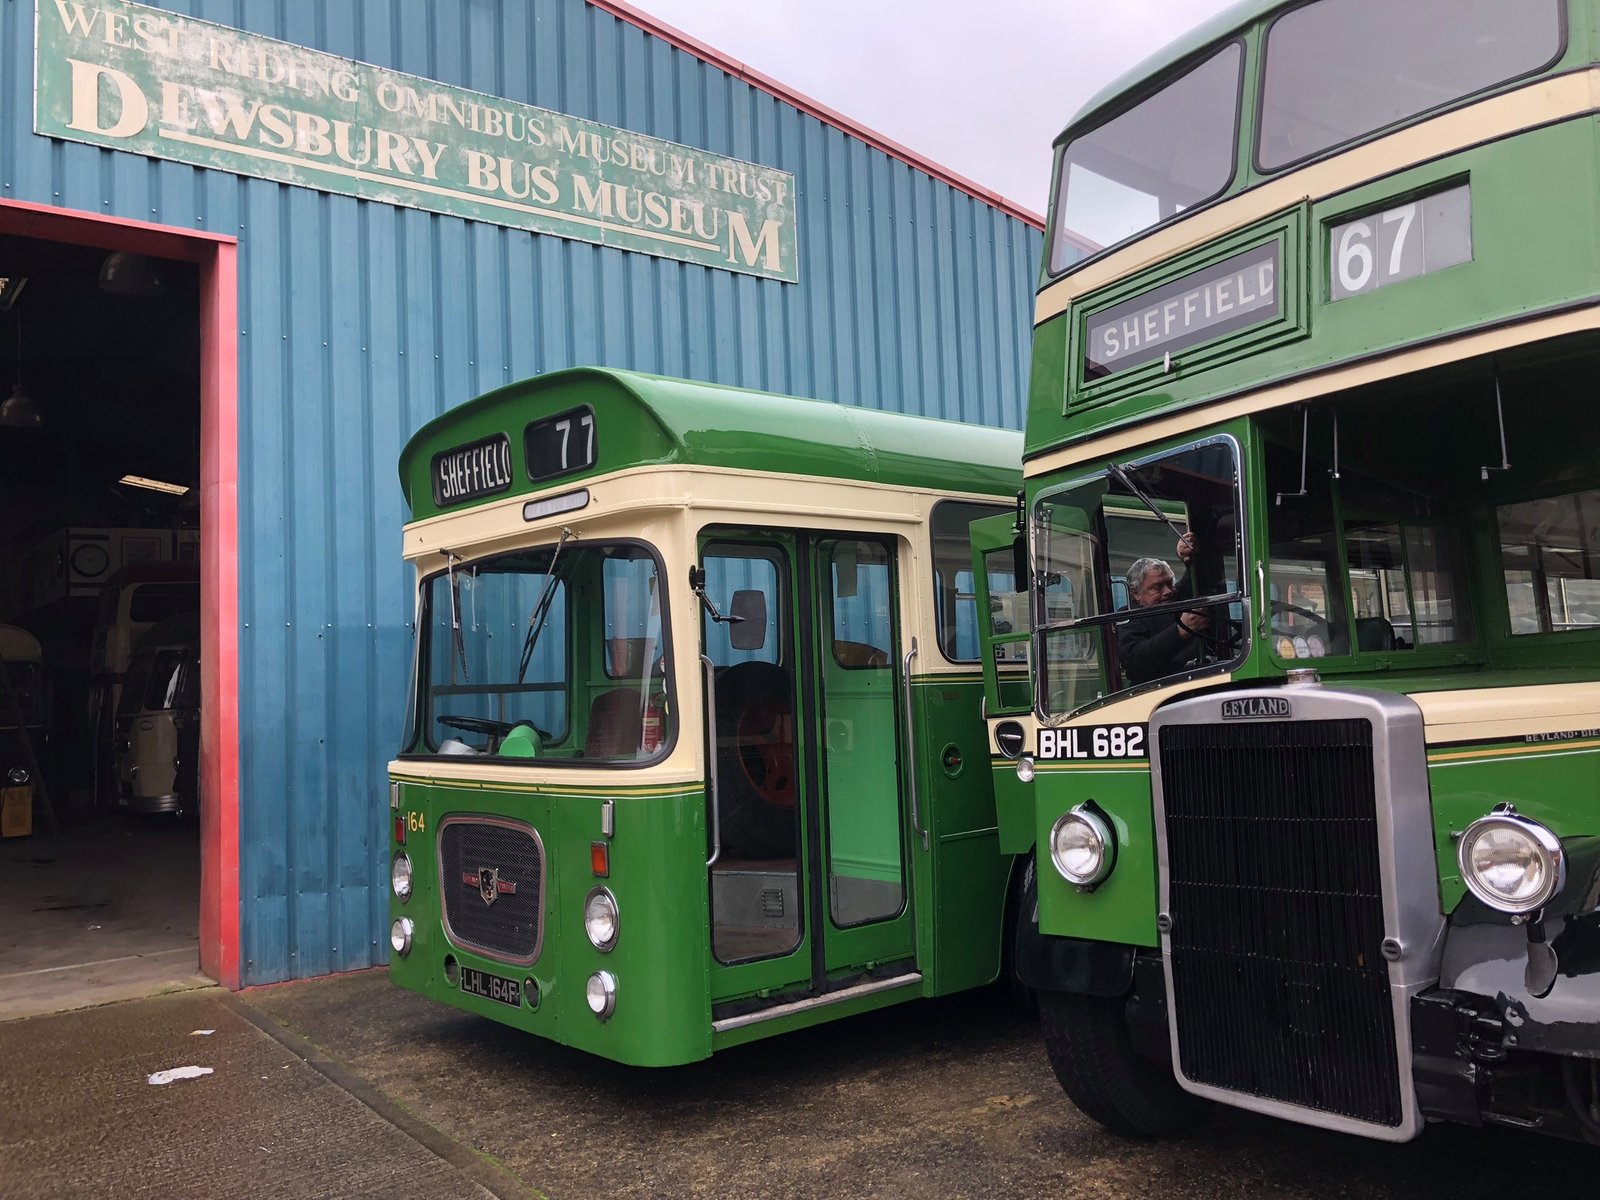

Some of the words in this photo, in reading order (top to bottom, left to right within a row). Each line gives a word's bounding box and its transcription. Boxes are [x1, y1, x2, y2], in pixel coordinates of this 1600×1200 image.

[54, 0, 184, 60] WEST
[208, 38, 361, 103] RIDING
[375, 80, 547, 146] OMNIBUS
[557, 125, 696, 185] MUSEUM
[702, 162, 787, 205] TRUST
[64, 57, 448, 182] DEWSBURY
[466, 150, 560, 205] BUS
[571, 174, 784, 273] MUSEUM
[1337, 203, 1418, 292] 67
[1104, 262, 1274, 357] SHEFFIELD
[440, 440, 510, 498] SHEFFIELD
[555, 414, 594, 470] 77
[1223, 699, 1289, 718] LEYLAND
[1525, 731, 1575, 742] LEYLAND
[1581, 729, 1600, 737] DIE
[1040, 729, 1088, 759] BHL
[1093, 726, 1144, 757] 682
[407, 811, 425, 833] 164
